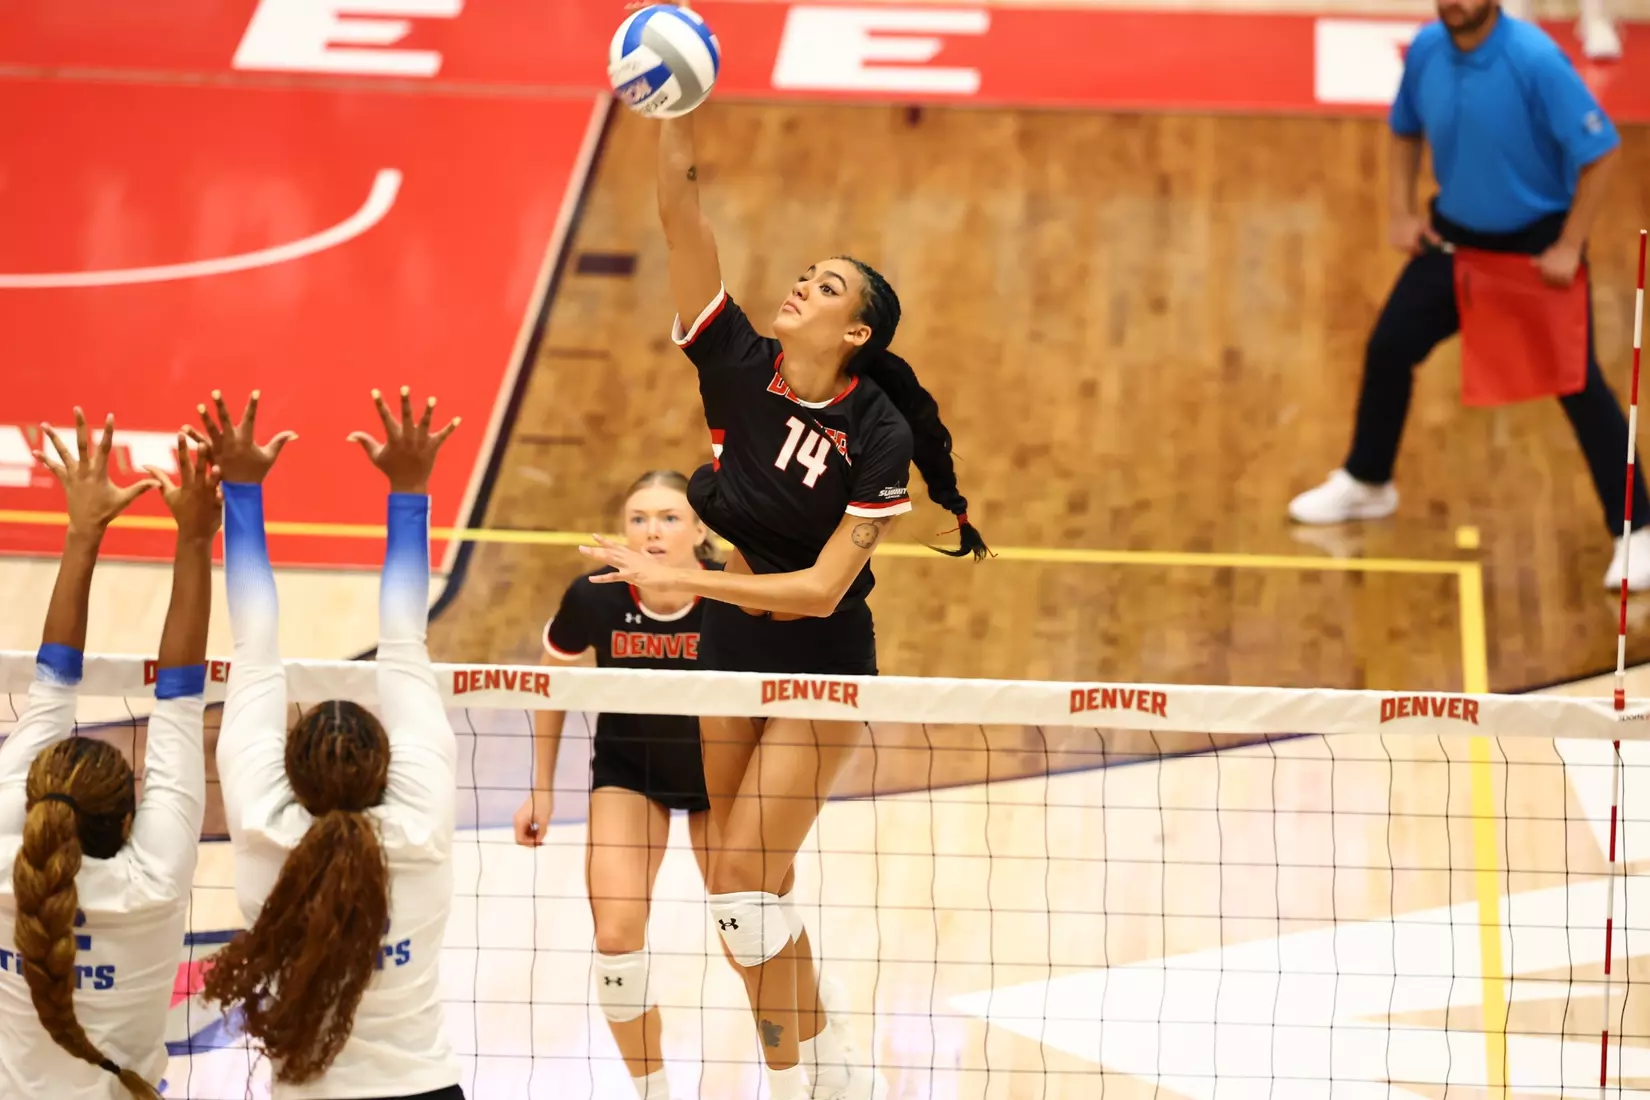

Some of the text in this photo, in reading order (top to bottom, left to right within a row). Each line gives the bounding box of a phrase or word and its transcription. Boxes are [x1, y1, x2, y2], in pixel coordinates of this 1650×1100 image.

[773, 415, 832, 489] 14
[611, 631, 700, 660] DENVE
[453, 670, 551, 698] DENVER
[761, 679, 858, 708] DENVER
[1070, 688, 1167, 719] DENVER
[1380, 696, 1479, 725] DENVER
